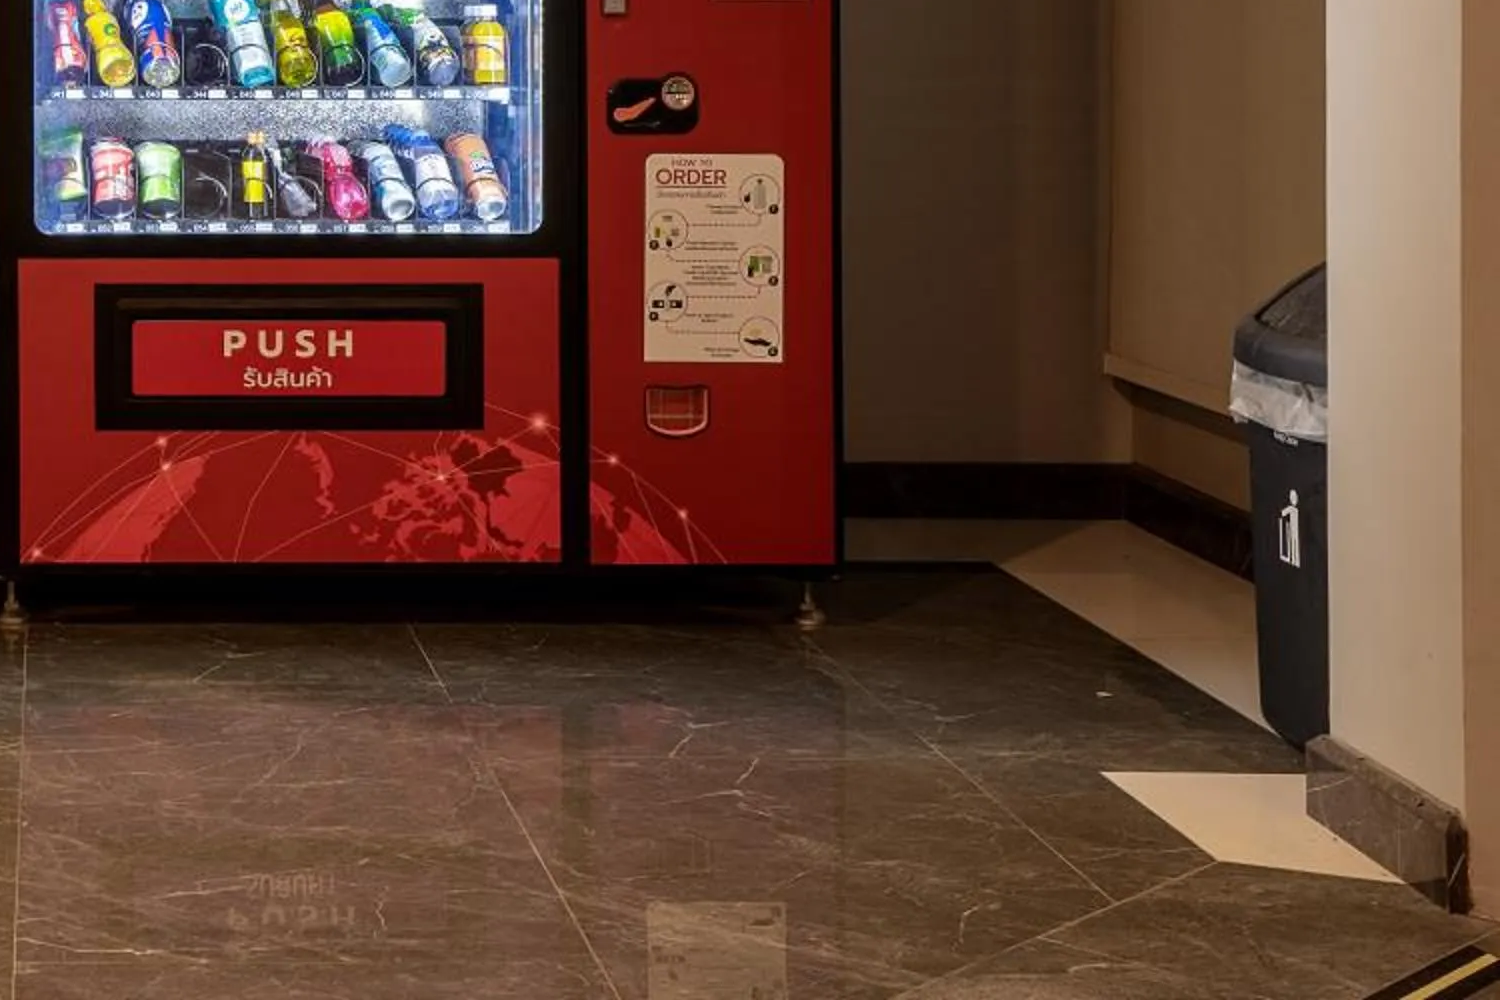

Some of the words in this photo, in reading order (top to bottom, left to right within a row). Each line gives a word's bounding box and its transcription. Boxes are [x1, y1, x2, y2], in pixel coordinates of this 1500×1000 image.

[656, 168, 727, 185] ORDER
[223, 329, 353, 358] PUSH
[243, 365, 332, 388] รับสินค้า
